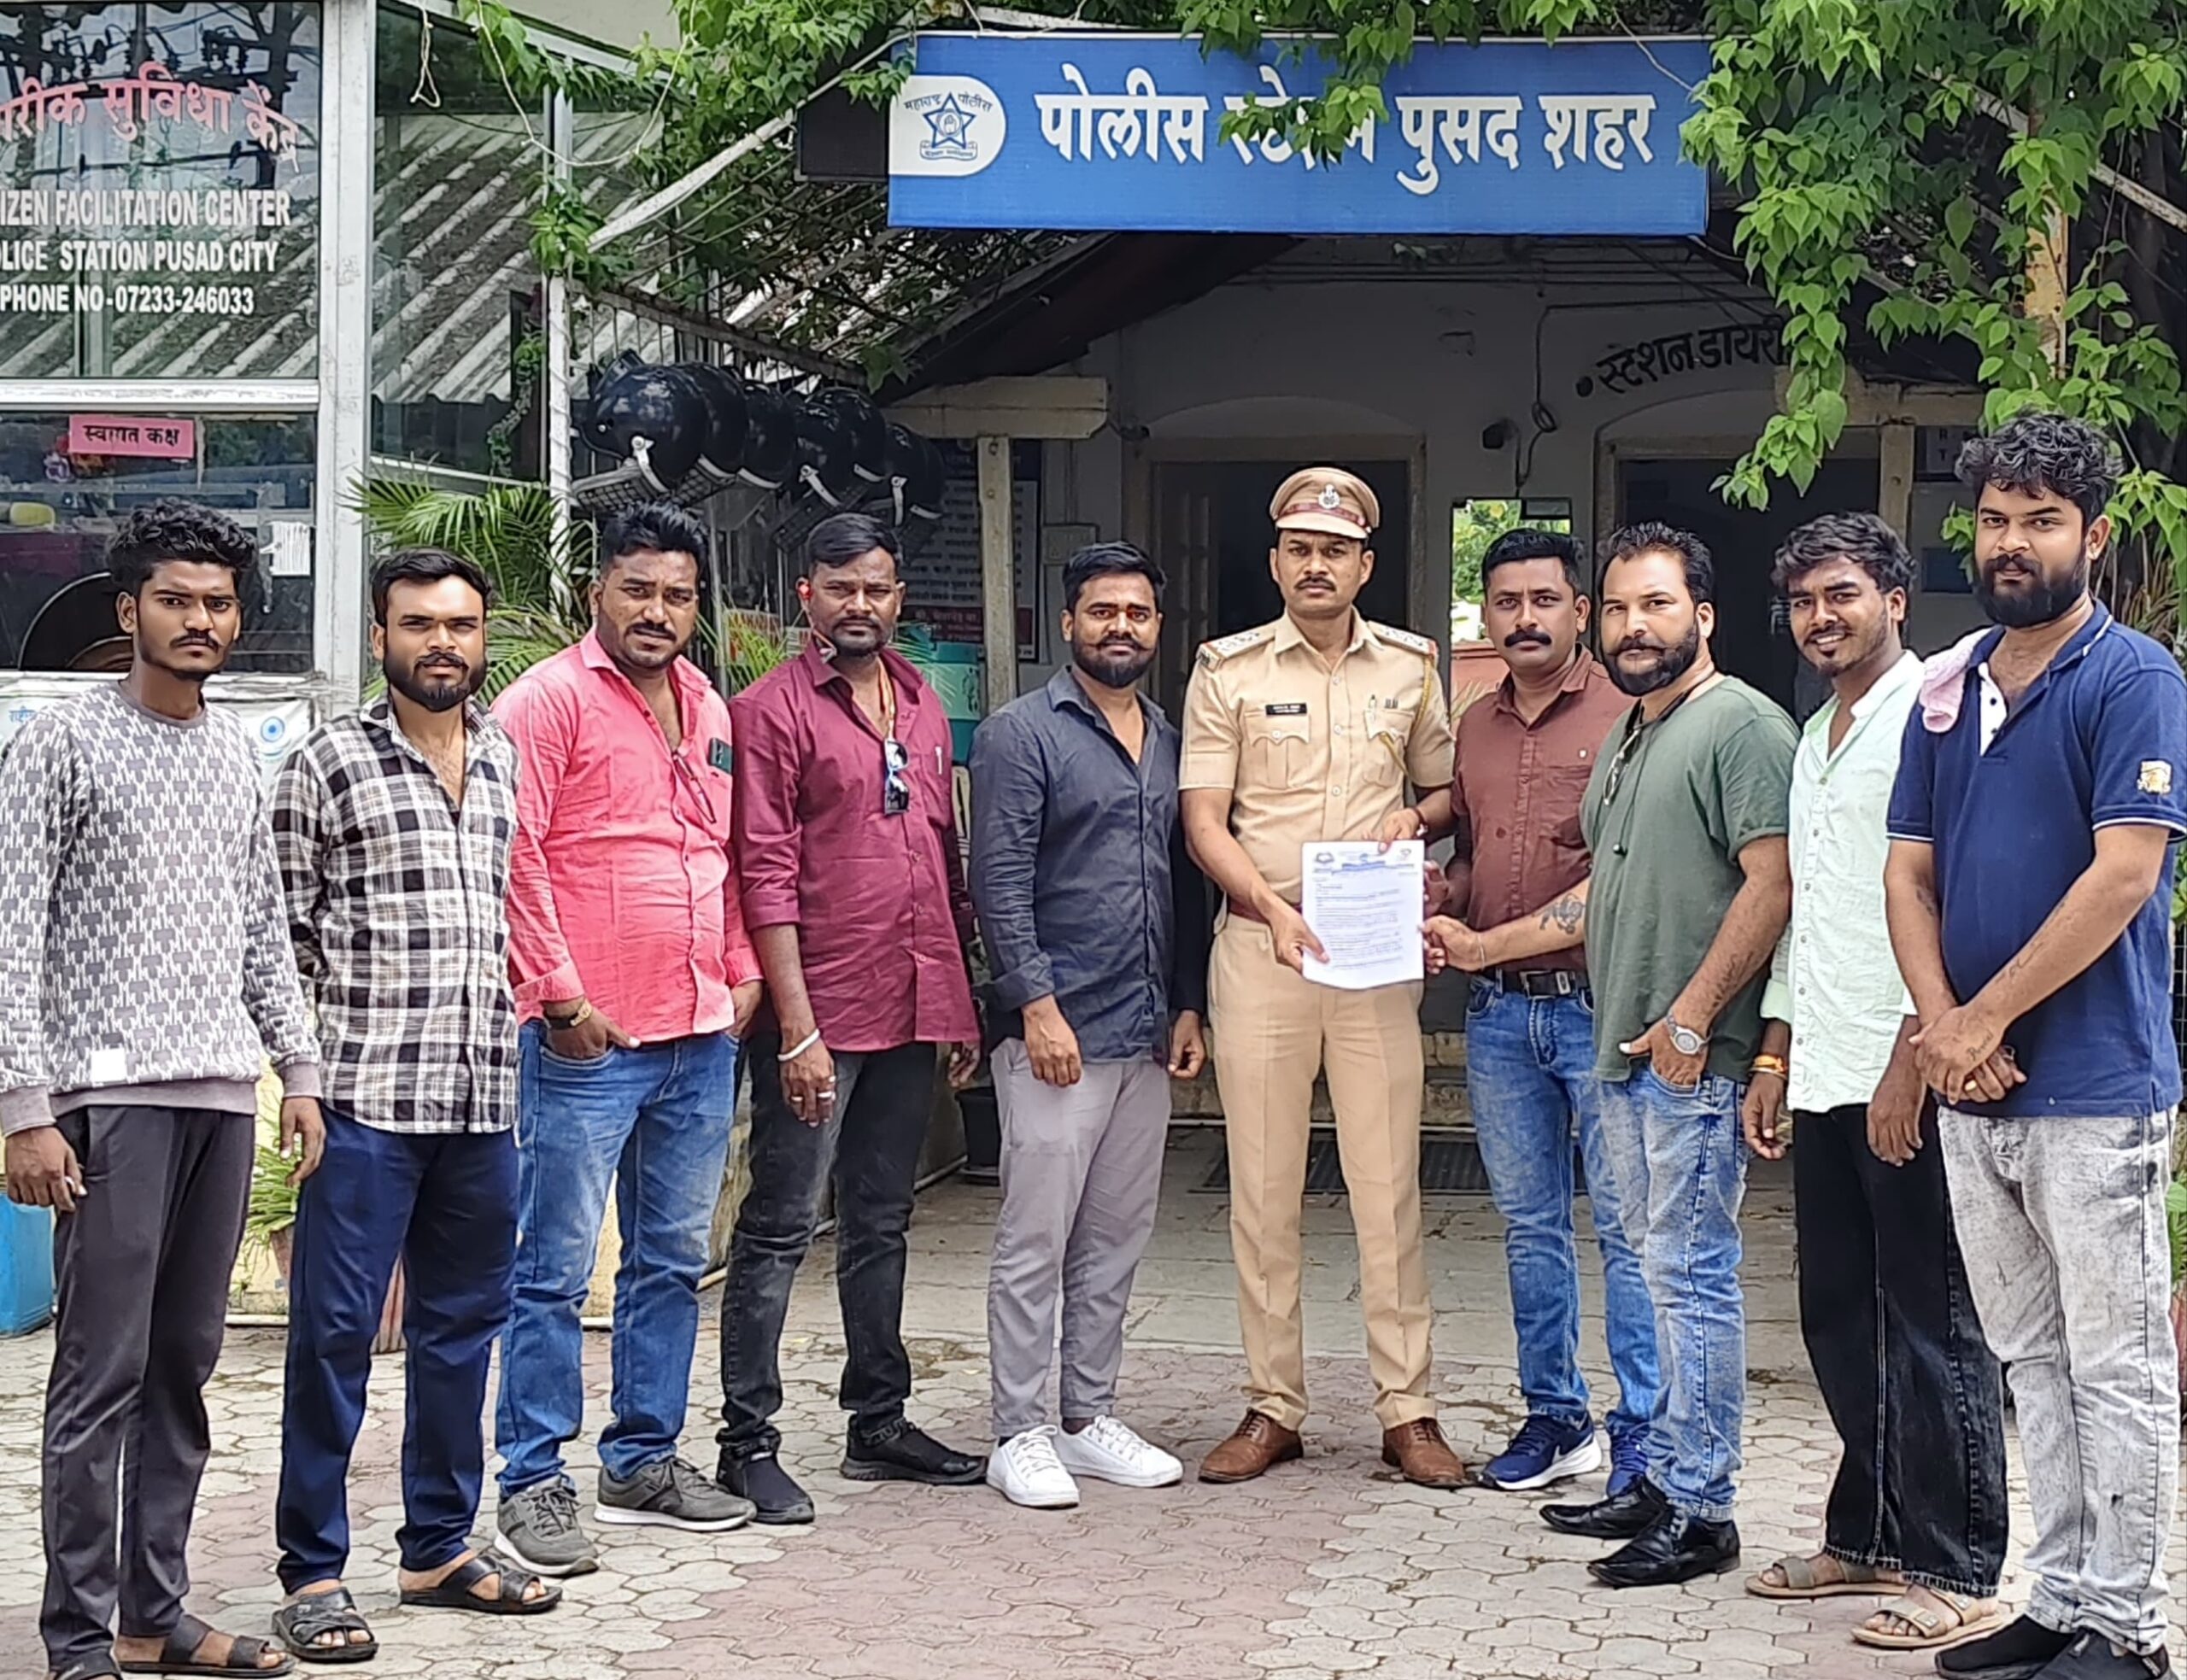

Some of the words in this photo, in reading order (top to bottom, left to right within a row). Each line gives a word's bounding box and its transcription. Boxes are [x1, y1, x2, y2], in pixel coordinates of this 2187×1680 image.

[100, 61, 233, 142] सुविधा
[1034, 62, 1210, 164] पोलीस
[1396, 96, 1522, 195] पुसद
[1539, 94, 1656, 170] शहर
[56, 190, 197, 226] FACILITATION
[204, 190, 291, 226] CENTER
[0, 240, 48, 272] LICE
[59, 240, 148, 272] STATION
[153, 240, 225, 272] PUSAD
[229, 240, 279, 272] CITY
[0, 284, 69, 313] PHONE
[83, 425, 139, 443] स्वागत
[145, 428, 180, 446] कक्ष
